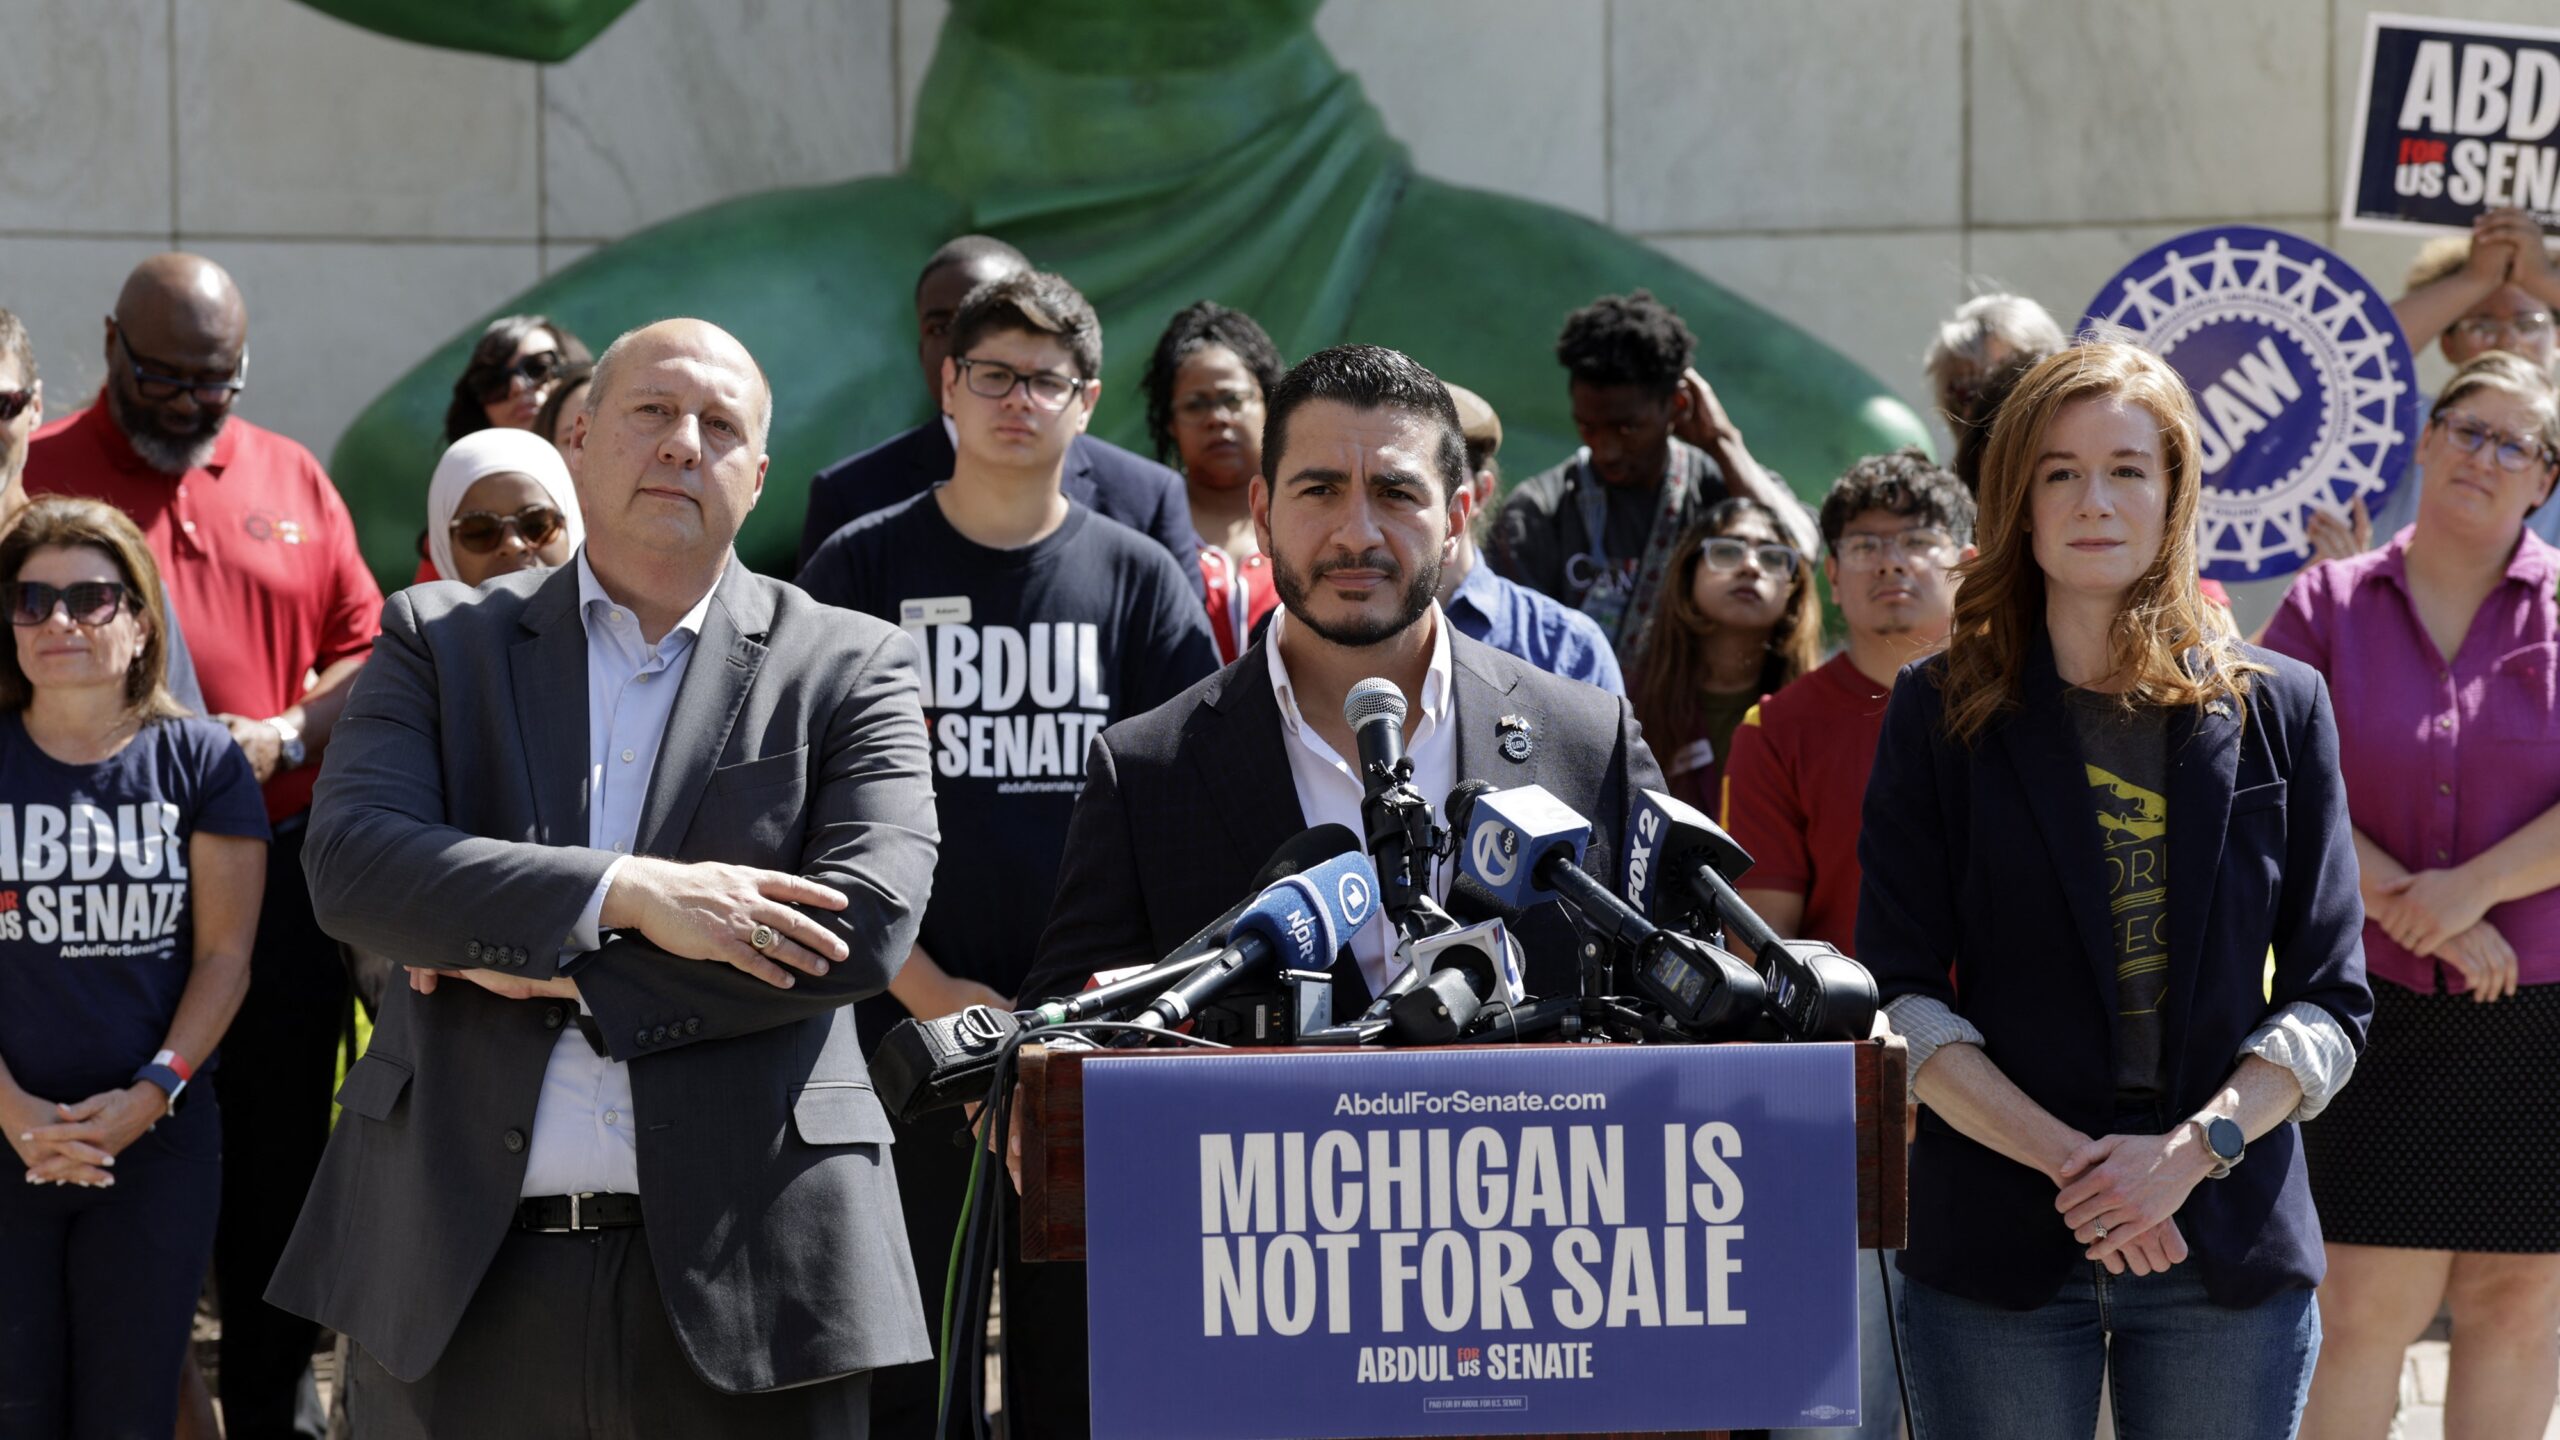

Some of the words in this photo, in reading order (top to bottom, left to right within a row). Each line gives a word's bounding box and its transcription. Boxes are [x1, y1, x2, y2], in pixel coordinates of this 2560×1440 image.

[2394, 161, 2445, 199] US
[2447, 138, 2560, 212] SEN
[2397, 138, 2447, 165] FOR
[2200, 336, 2303, 475] UAW
[1639, 808, 1660, 844] 2
[1628, 833, 1652, 913] FOX
[26, 883, 187, 944] SENATE
[1333, 1089, 1607, 1117] AbdulForSenate.com
[1199, 1124, 1626, 1234] MICHIGAN
[1664, 1121, 1745, 1224] IS
[1201, 1233, 1360, 1337] NOT
[1380, 1230, 1535, 1333] FOR
[1551, 1224, 1747, 1330] SALE
[1357, 1345, 1454, 1383] ABDUL
[1457, 1347, 1480, 1361] FOR
[1457, 1359, 1481, 1377] US
[1487, 1342, 1593, 1381] SENATE
